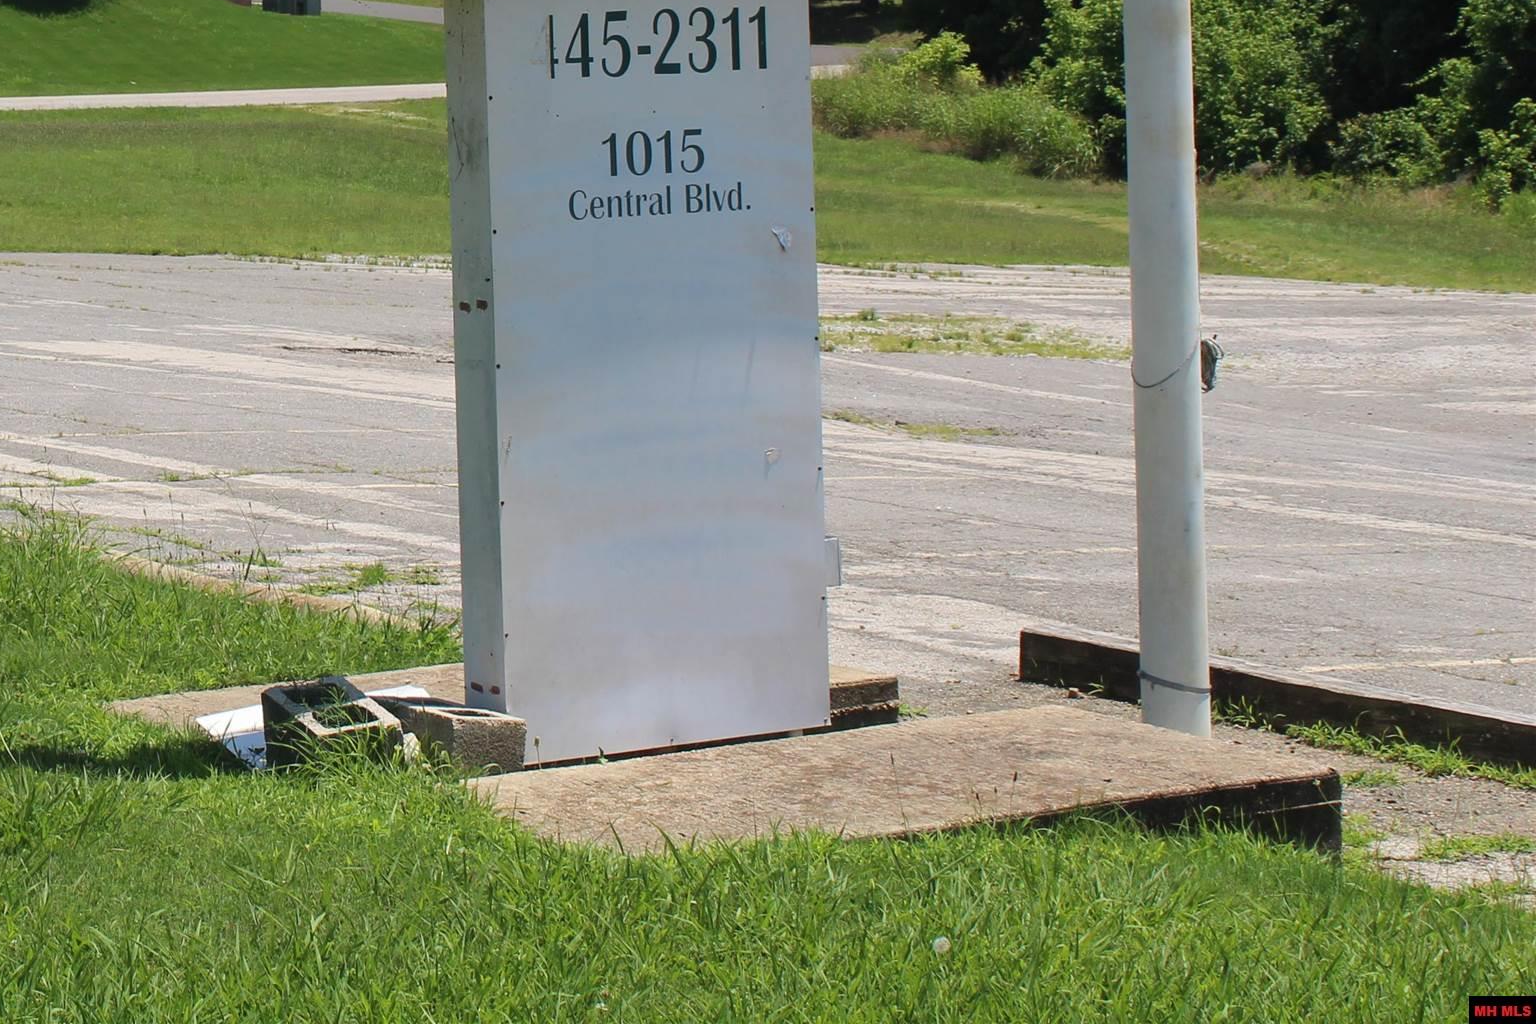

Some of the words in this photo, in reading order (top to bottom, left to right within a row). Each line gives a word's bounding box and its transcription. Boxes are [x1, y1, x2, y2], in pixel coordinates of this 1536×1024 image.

[601, 128, 706, 177] 1015
[568, 185, 672, 220] Central
[684, 181, 752, 214] Blvd.
